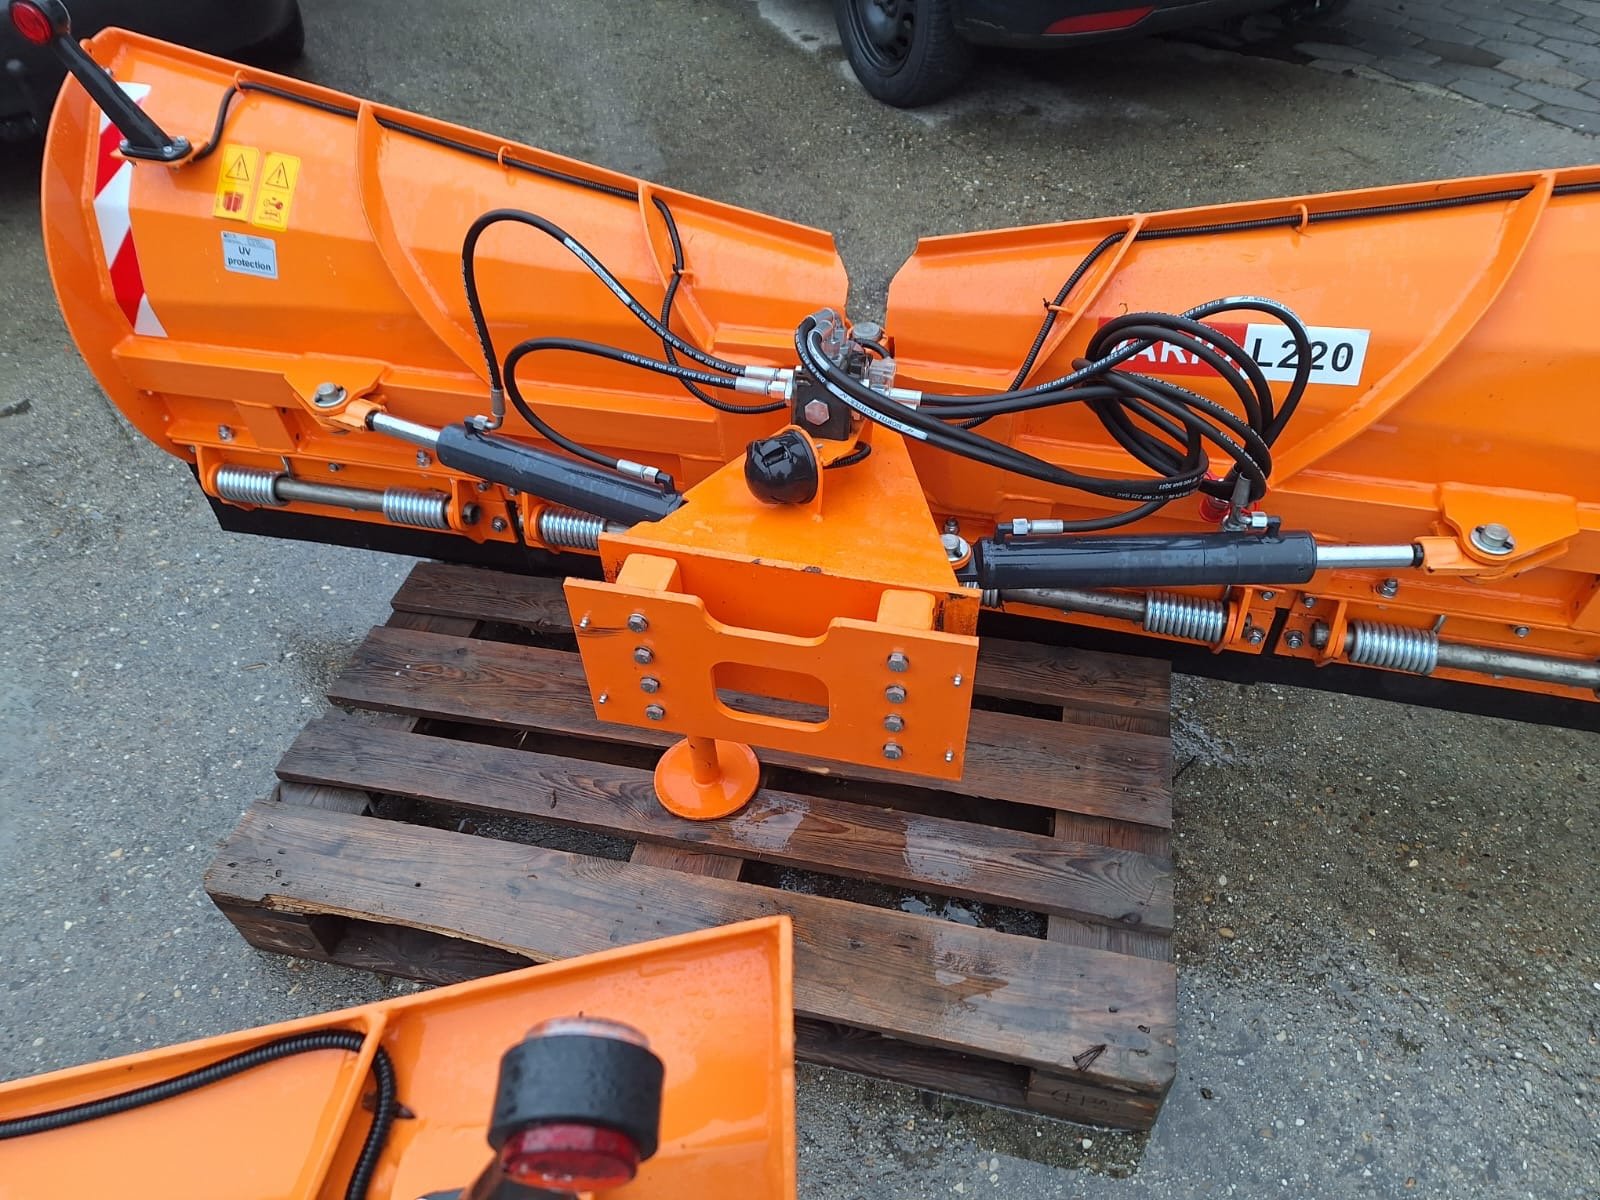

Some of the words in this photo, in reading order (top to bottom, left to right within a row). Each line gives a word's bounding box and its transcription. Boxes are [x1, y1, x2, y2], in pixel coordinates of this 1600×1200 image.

[238, 246, 251, 256] UV
[227, 256, 272, 271] protection
[1252, 337, 1354, 372] L220
